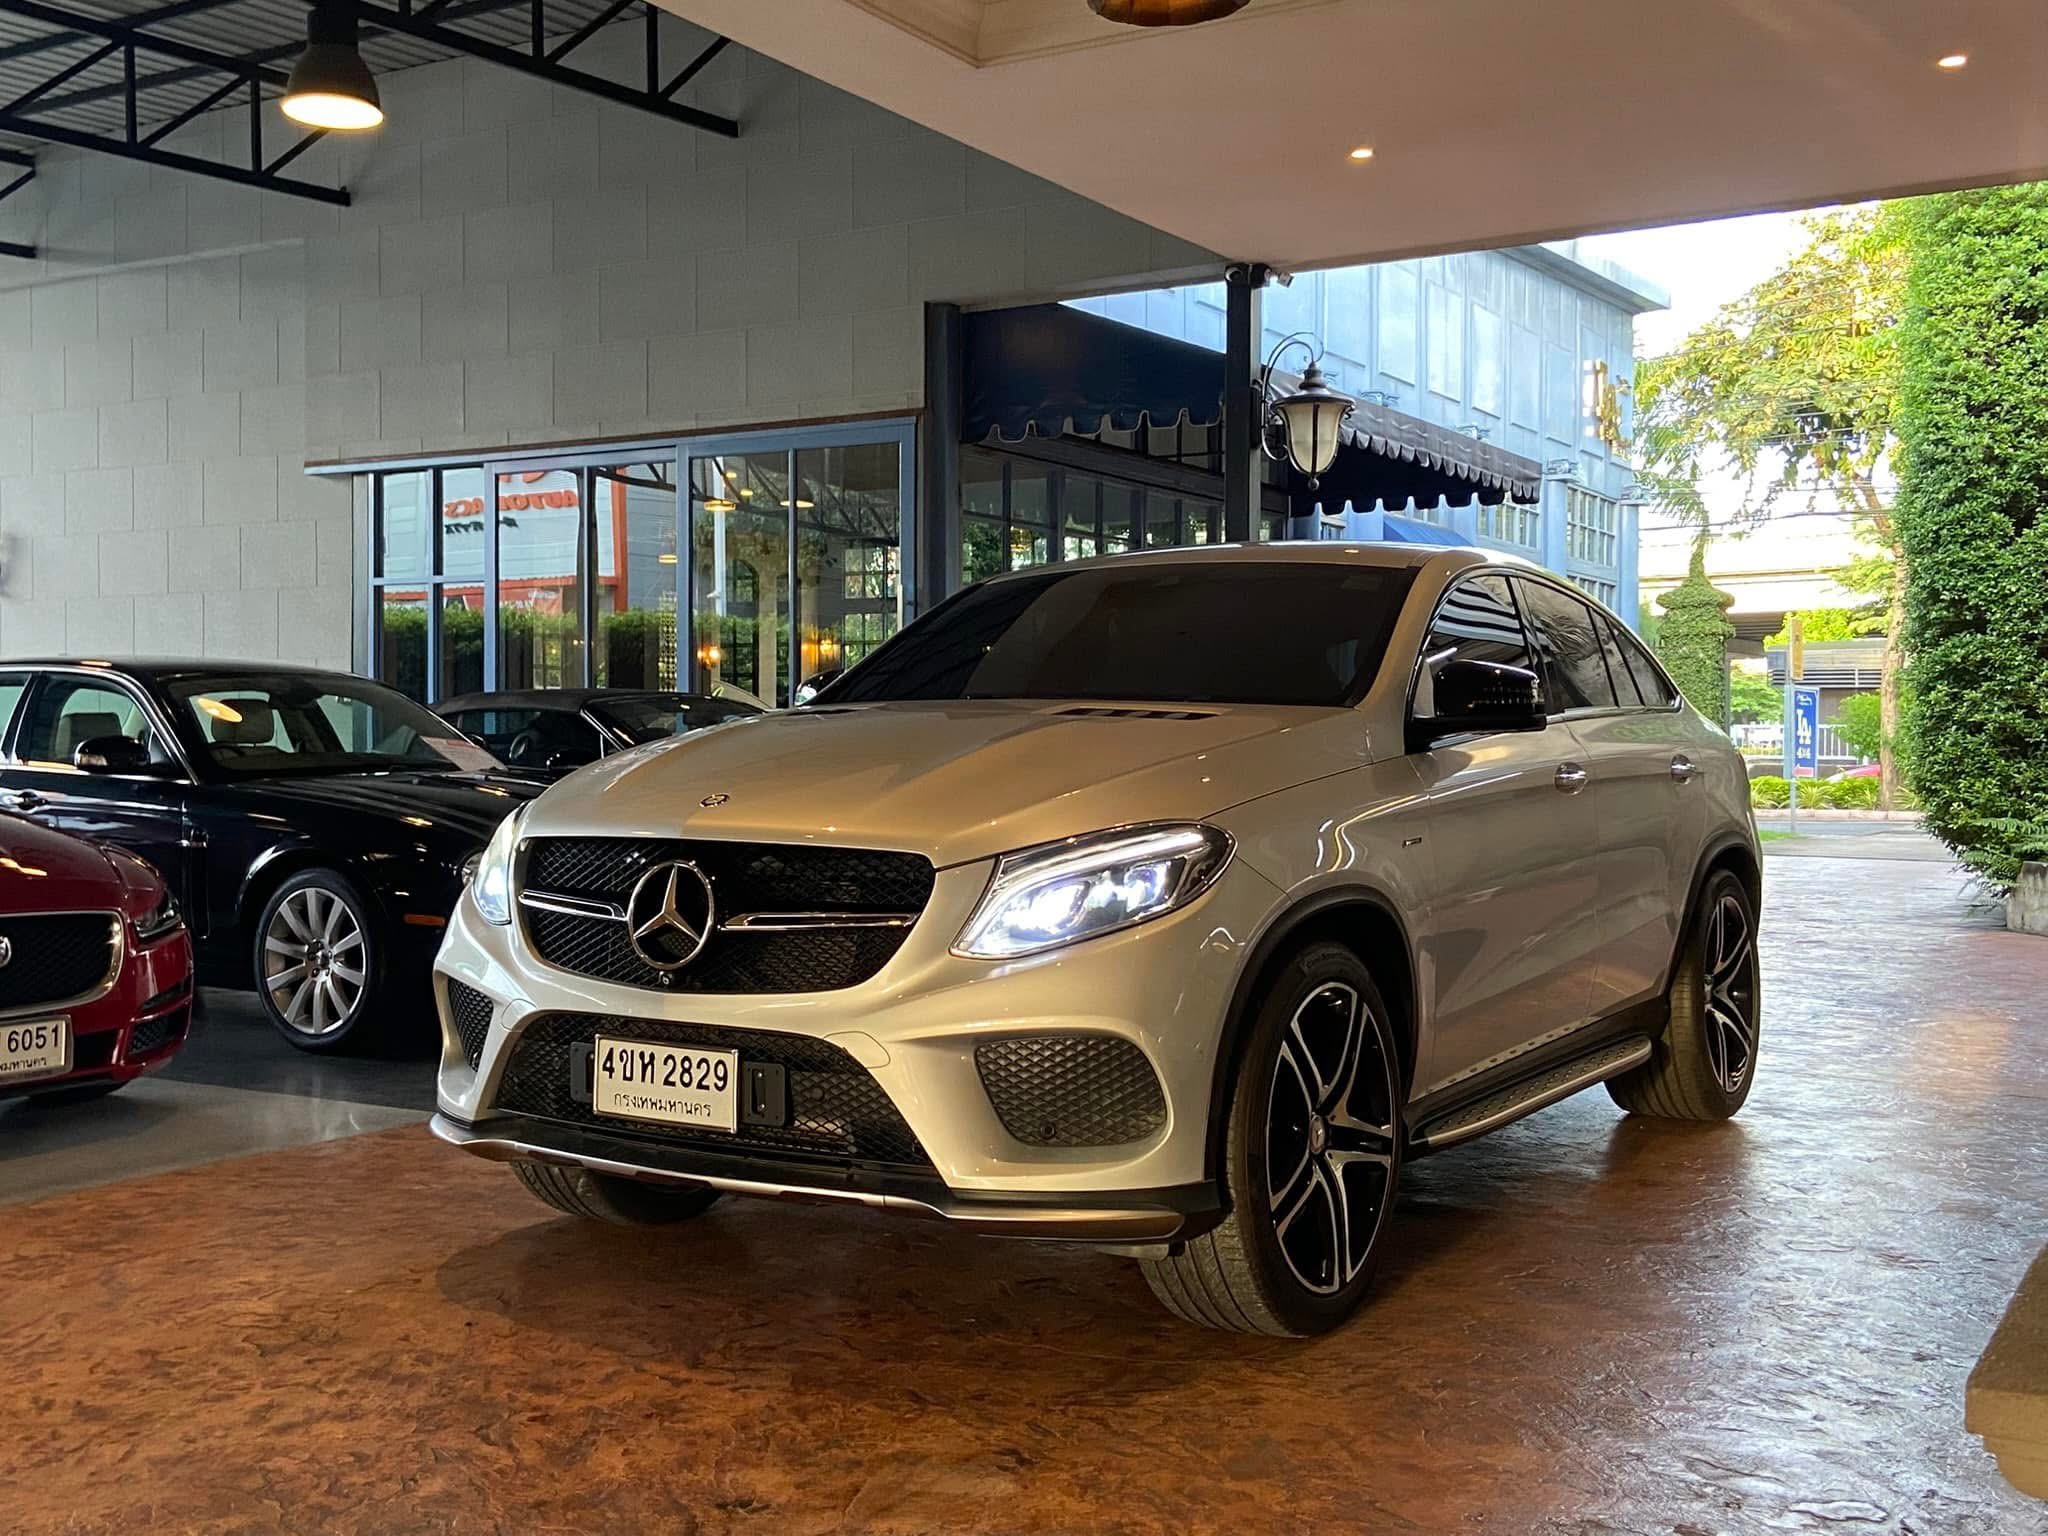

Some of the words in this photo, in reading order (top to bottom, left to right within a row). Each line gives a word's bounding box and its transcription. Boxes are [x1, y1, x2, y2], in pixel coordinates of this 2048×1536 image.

[8, 1024, 59, 1053] 6051
[662, 1054, 728, 1092] 2829
[614, 1092, 712, 1117] กรุงเทพมหานคร
